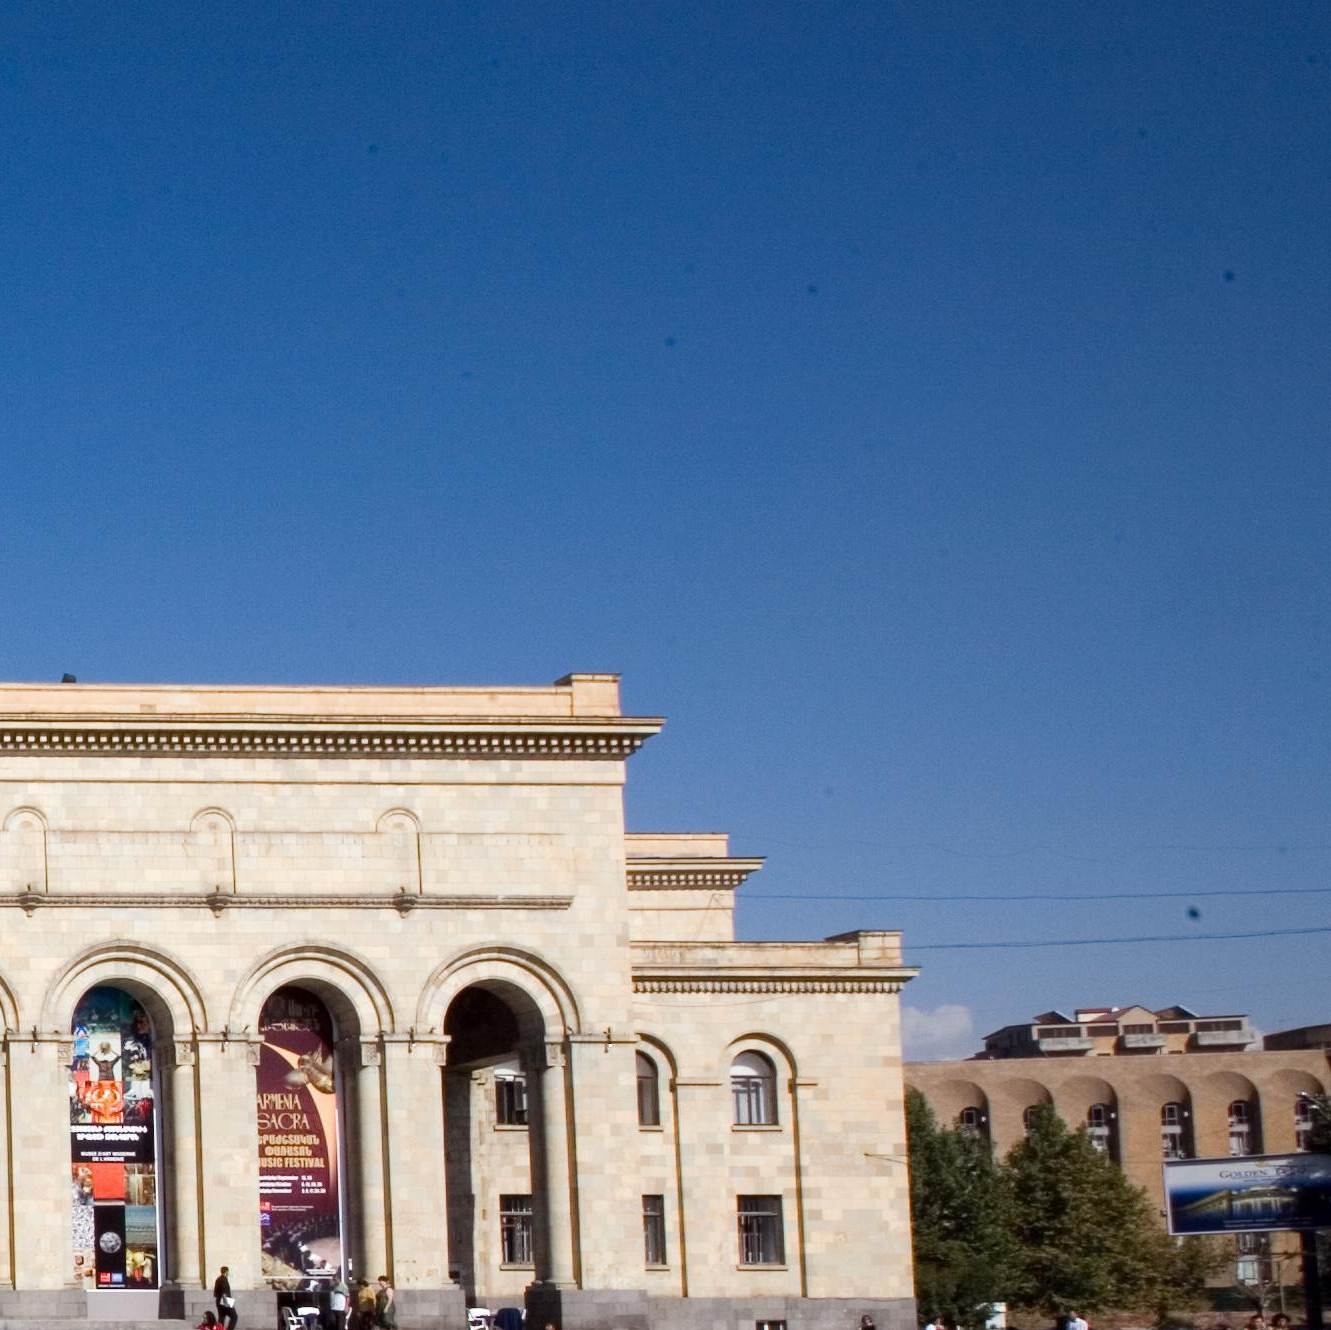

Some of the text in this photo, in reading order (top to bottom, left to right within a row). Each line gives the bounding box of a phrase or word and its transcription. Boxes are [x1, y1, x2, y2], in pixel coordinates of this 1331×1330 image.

[257, 1092, 302, 1111] ARMENIA
[257, 1111, 310, 1130] SACRA
[284, 1156, 326, 1169] FESTIVAL
